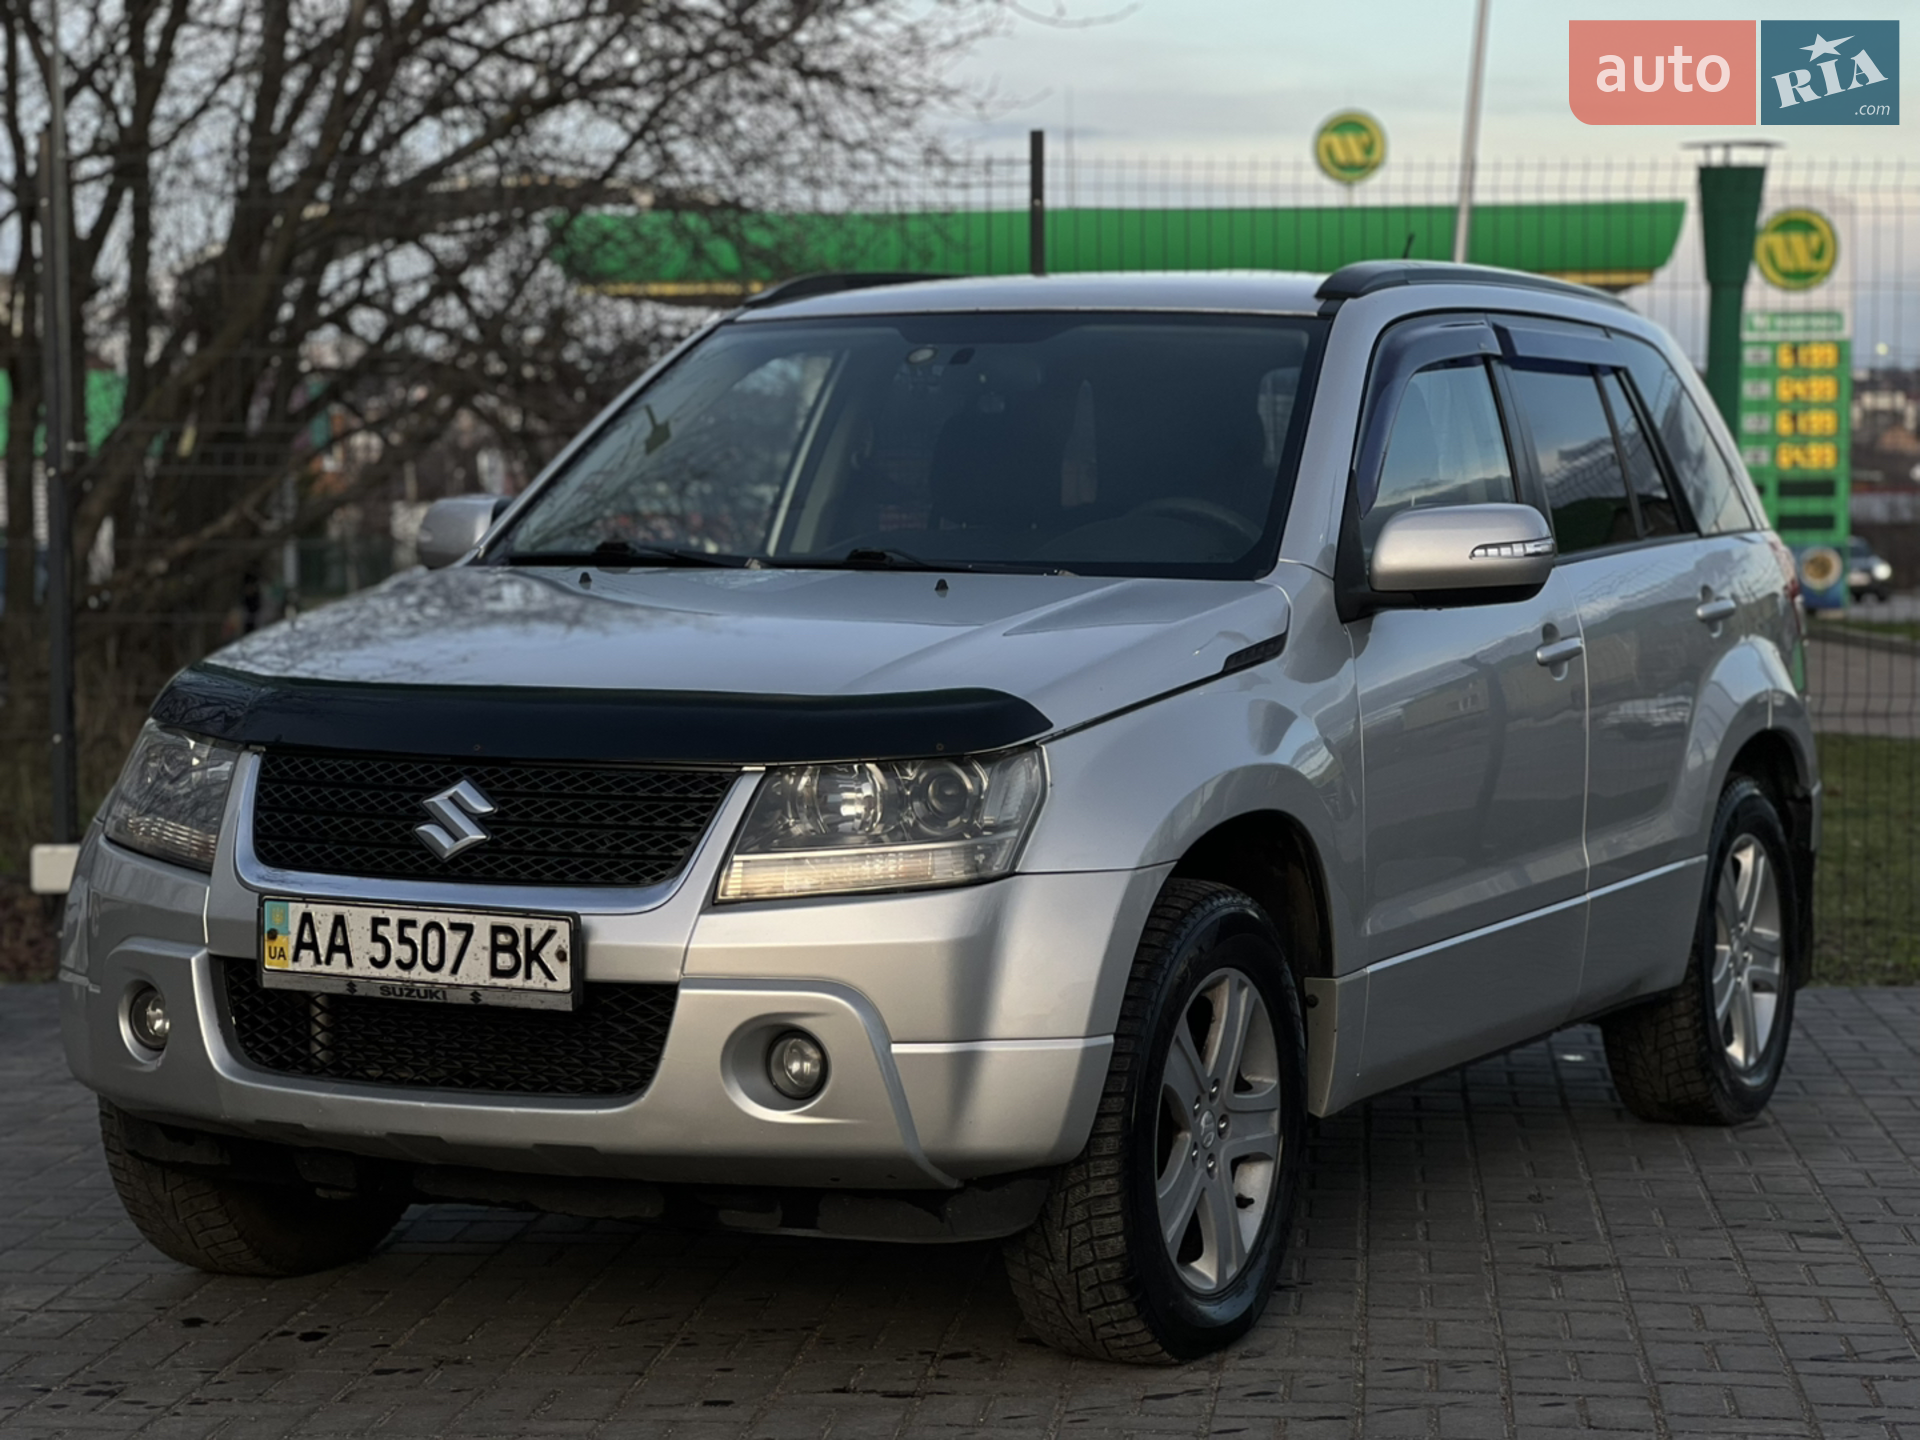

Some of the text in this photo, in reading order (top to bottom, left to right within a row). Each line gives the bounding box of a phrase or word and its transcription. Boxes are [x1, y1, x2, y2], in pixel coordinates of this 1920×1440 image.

[268, 945, 287, 962] UA
[292, 911, 558, 982] AA 5507 BK
[379, 985, 448, 1001] SUZUKI
